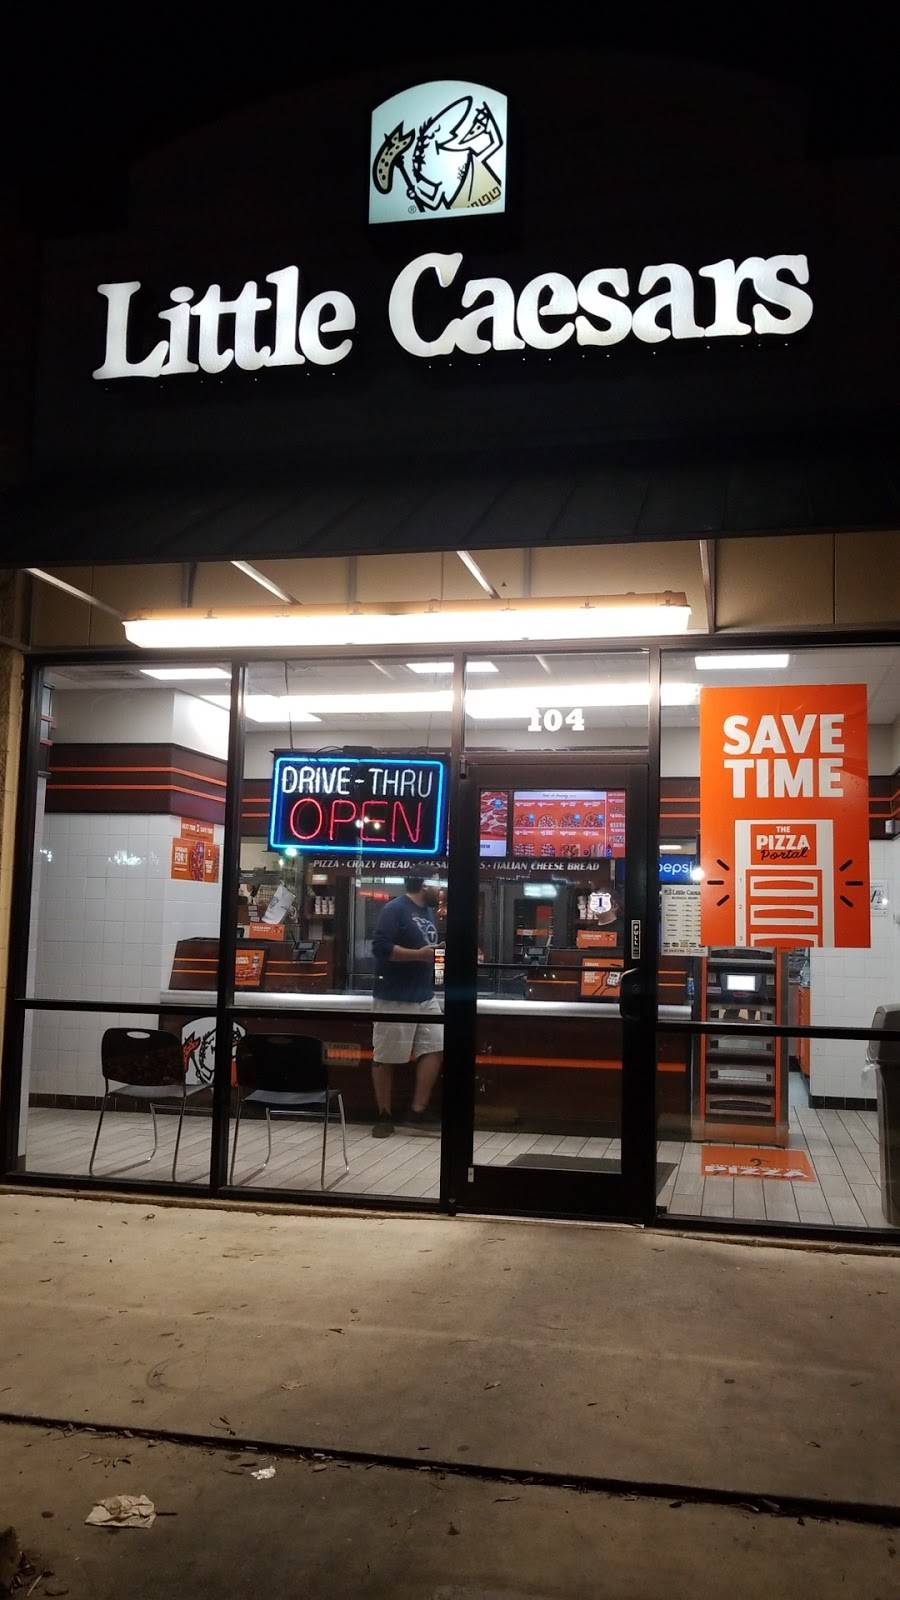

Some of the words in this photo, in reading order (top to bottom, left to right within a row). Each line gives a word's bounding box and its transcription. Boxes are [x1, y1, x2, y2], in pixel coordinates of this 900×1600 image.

[92, 265, 356, 379] Little
[388, 252, 814, 357] Caesars
[528, 707, 585, 732] 104
[723, 713, 845, 755] SAVE
[281, 765, 434, 798] DRIVE-THRU
[723, 758, 844, 799] TIME
[289, 798, 422, 843] OPEN
[776, 825, 791, 833] THE
[756, 834, 811, 850] PIZZA
[760, 846, 809, 860] Portal
[313, 860, 340, 868] PIZZA
[346, 860, 377, 868] CRAZY
[493, 861, 528, 870] ITALIAN
[530, 862, 565, 871] CHEESE
[567, 862, 600, 871] BREAD
